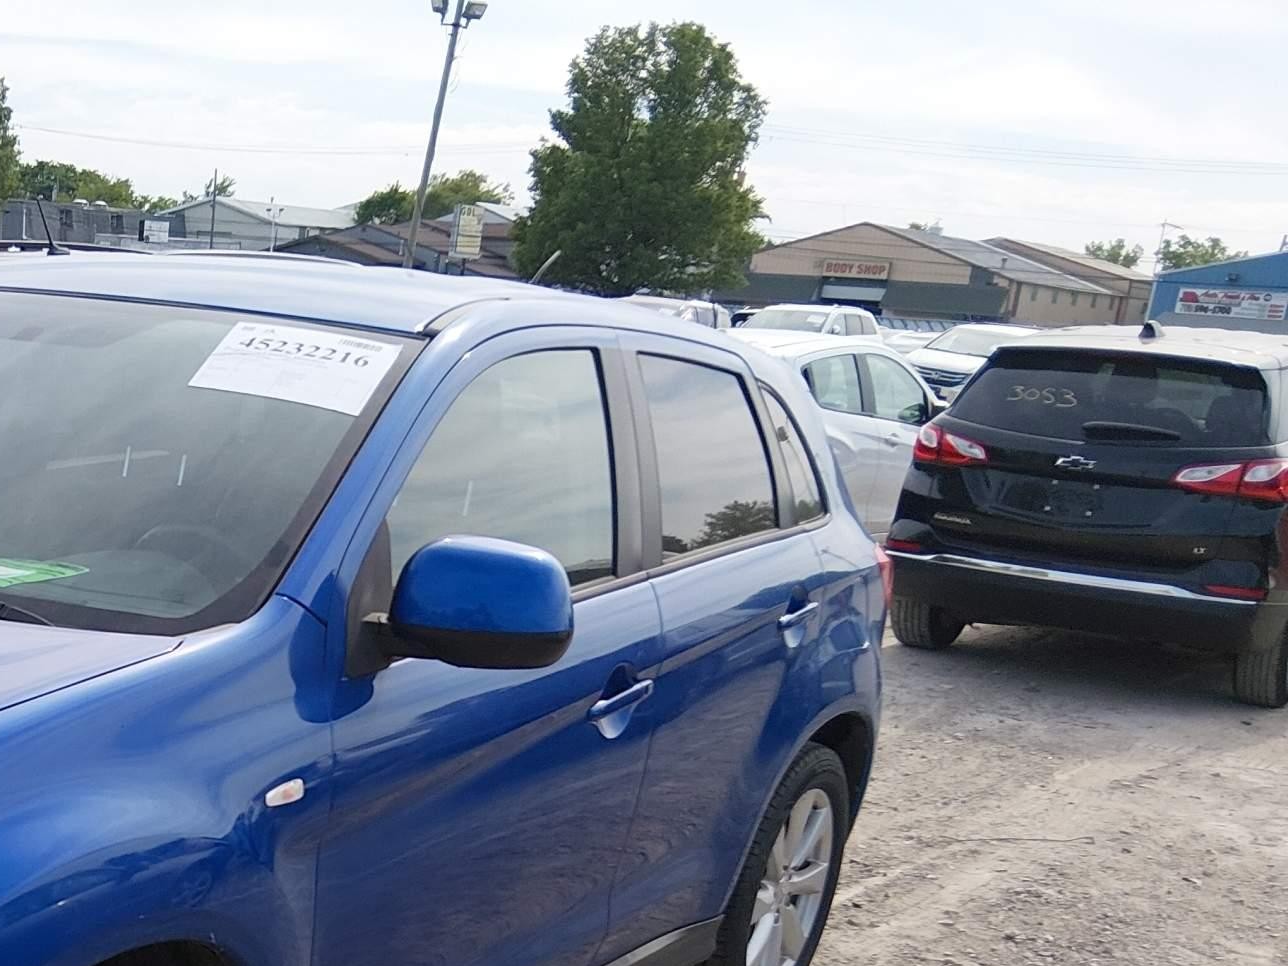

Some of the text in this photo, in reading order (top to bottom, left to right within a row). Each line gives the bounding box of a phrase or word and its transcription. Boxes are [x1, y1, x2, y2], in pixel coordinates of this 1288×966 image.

[825, 262, 886, 275] BODY SHOP
[239, 336, 370, 368] 45232216
[1006, 385, 1078, 408] 3053
